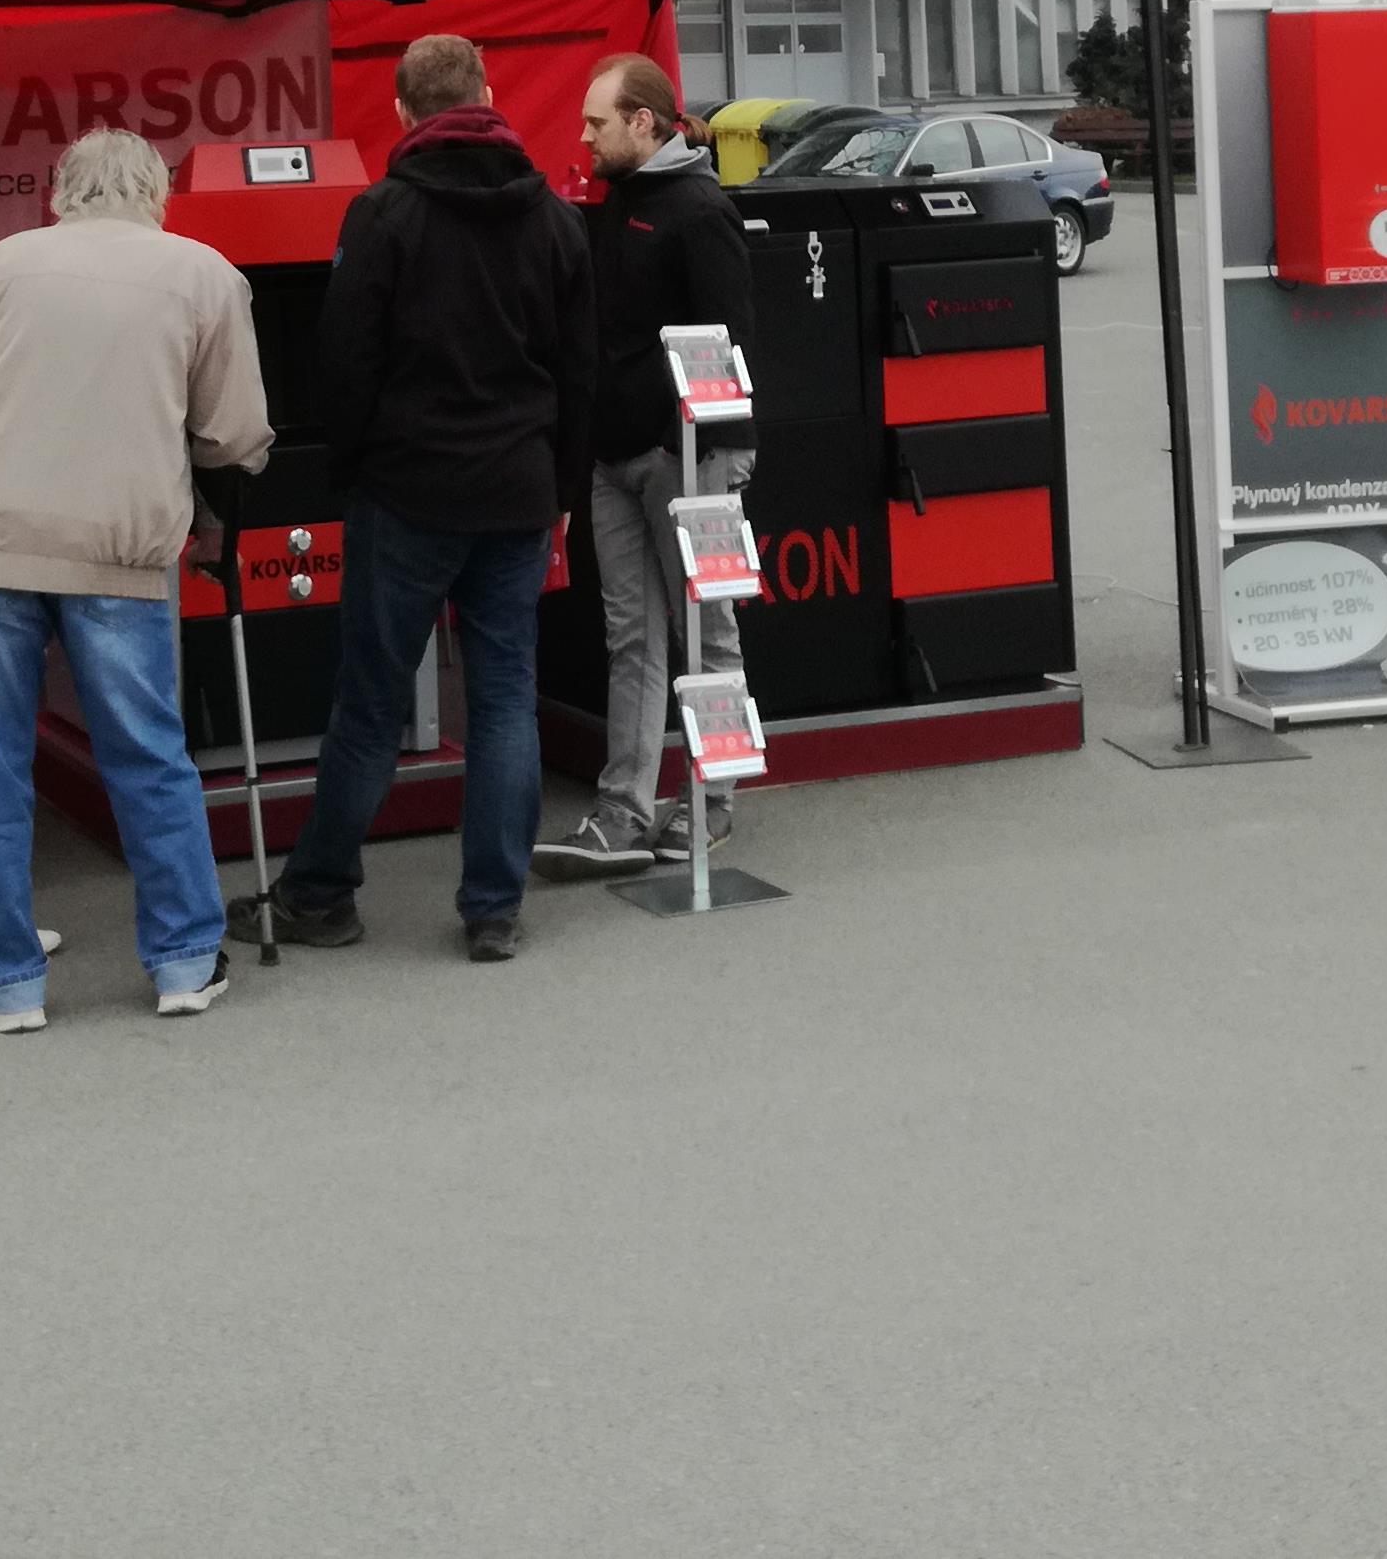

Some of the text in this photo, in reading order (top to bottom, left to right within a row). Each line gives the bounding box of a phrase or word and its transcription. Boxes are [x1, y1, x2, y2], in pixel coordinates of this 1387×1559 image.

[1231, 482, 1302, 510] Plynový
[1245, 568, 1375, 599] účinnost 107%
[1332, 596, 1375, 617] 28%
[1254, 633, 1280, 653] 20
[1294, 629, 1320, 648] 35
[1323, 625, 1354, 644] kW
